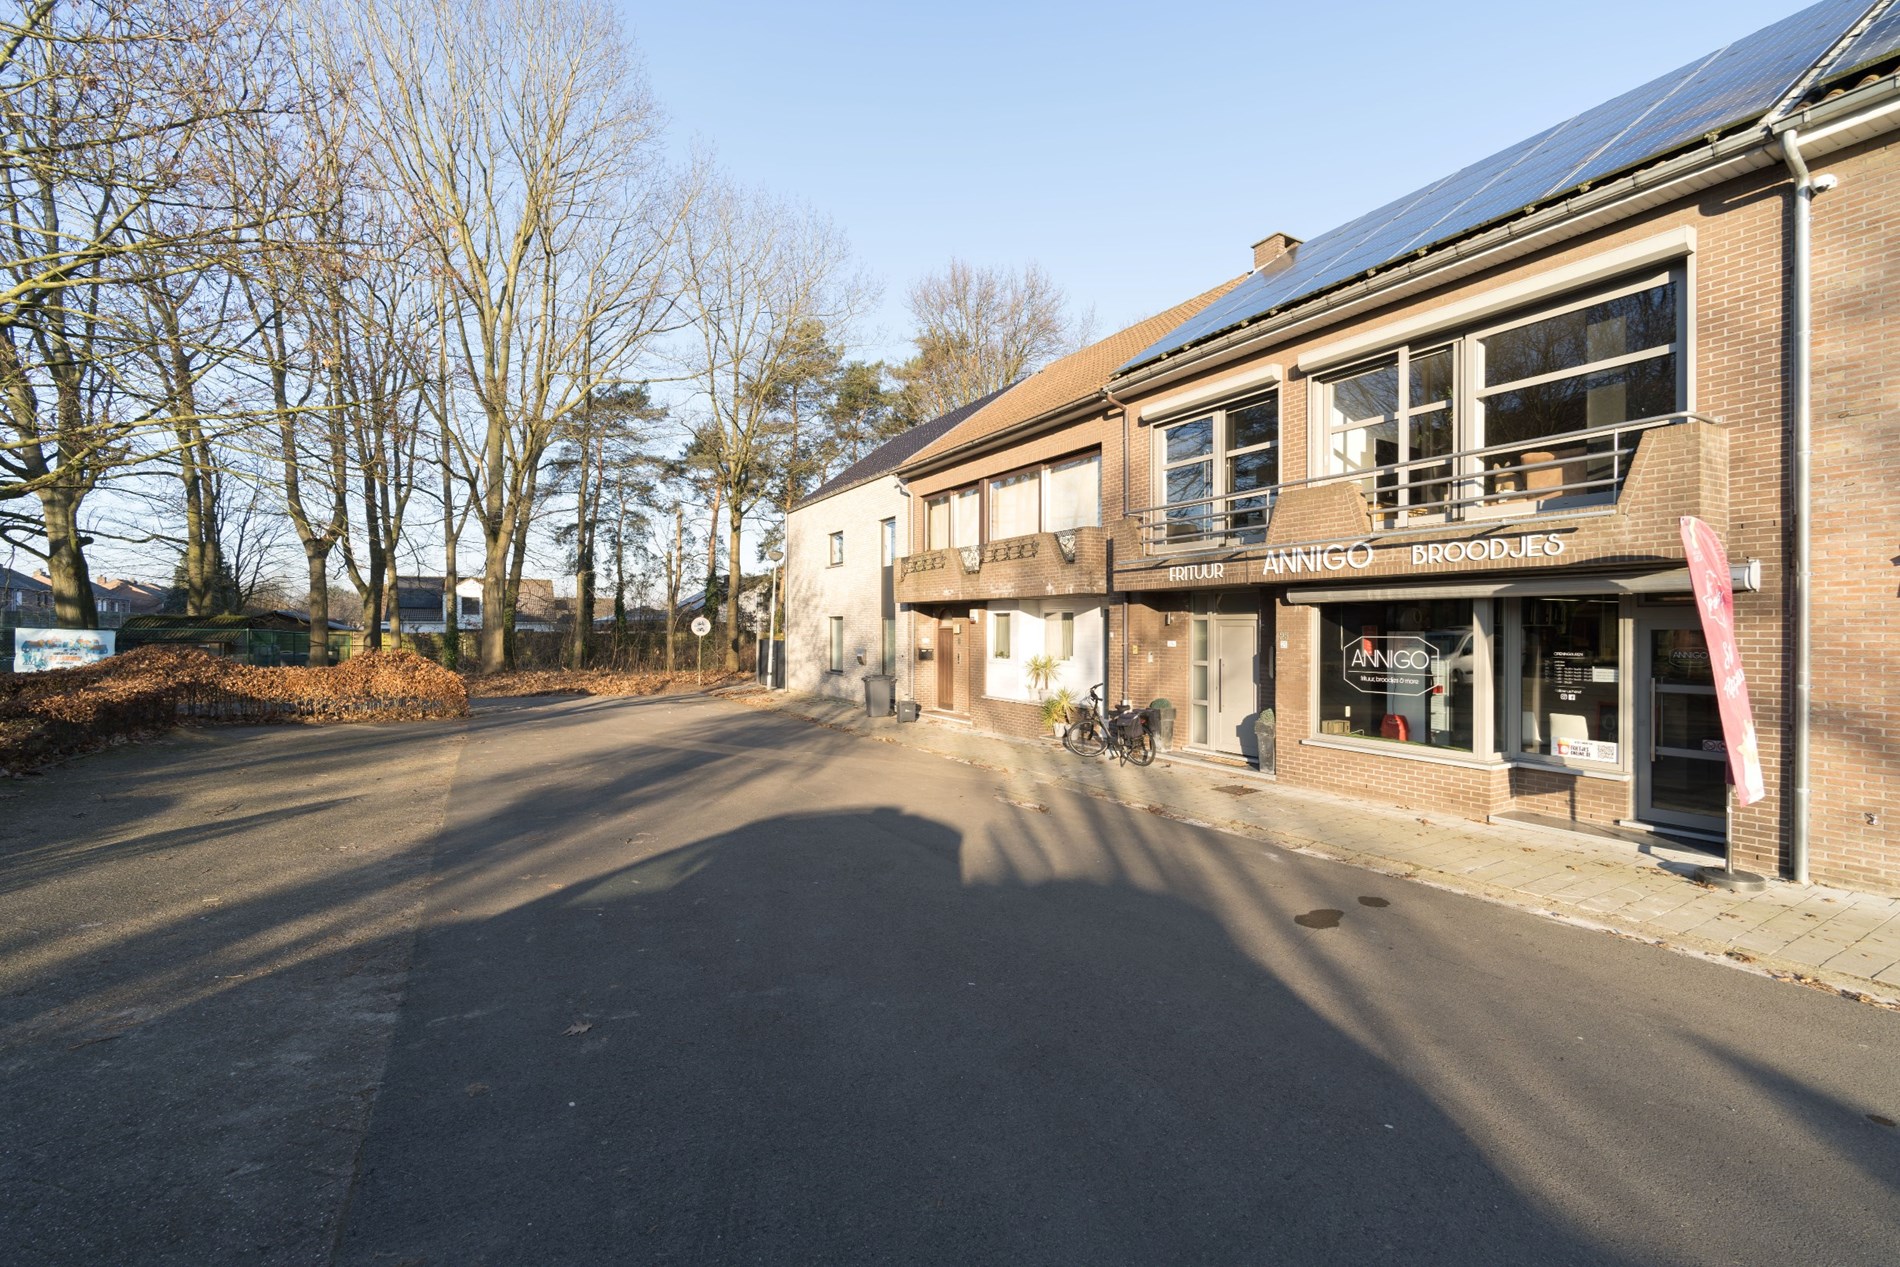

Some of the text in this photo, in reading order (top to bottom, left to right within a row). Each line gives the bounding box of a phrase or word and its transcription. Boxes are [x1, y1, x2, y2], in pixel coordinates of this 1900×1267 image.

[1262, 533, 1565, 576] ANNIGO BROODJES
[1169, 562, 1224, 582] FRITUUR
[1351, 648, 1430, 670] ANNIGO
[1672, 651, 1708, 660] ANNIGO
